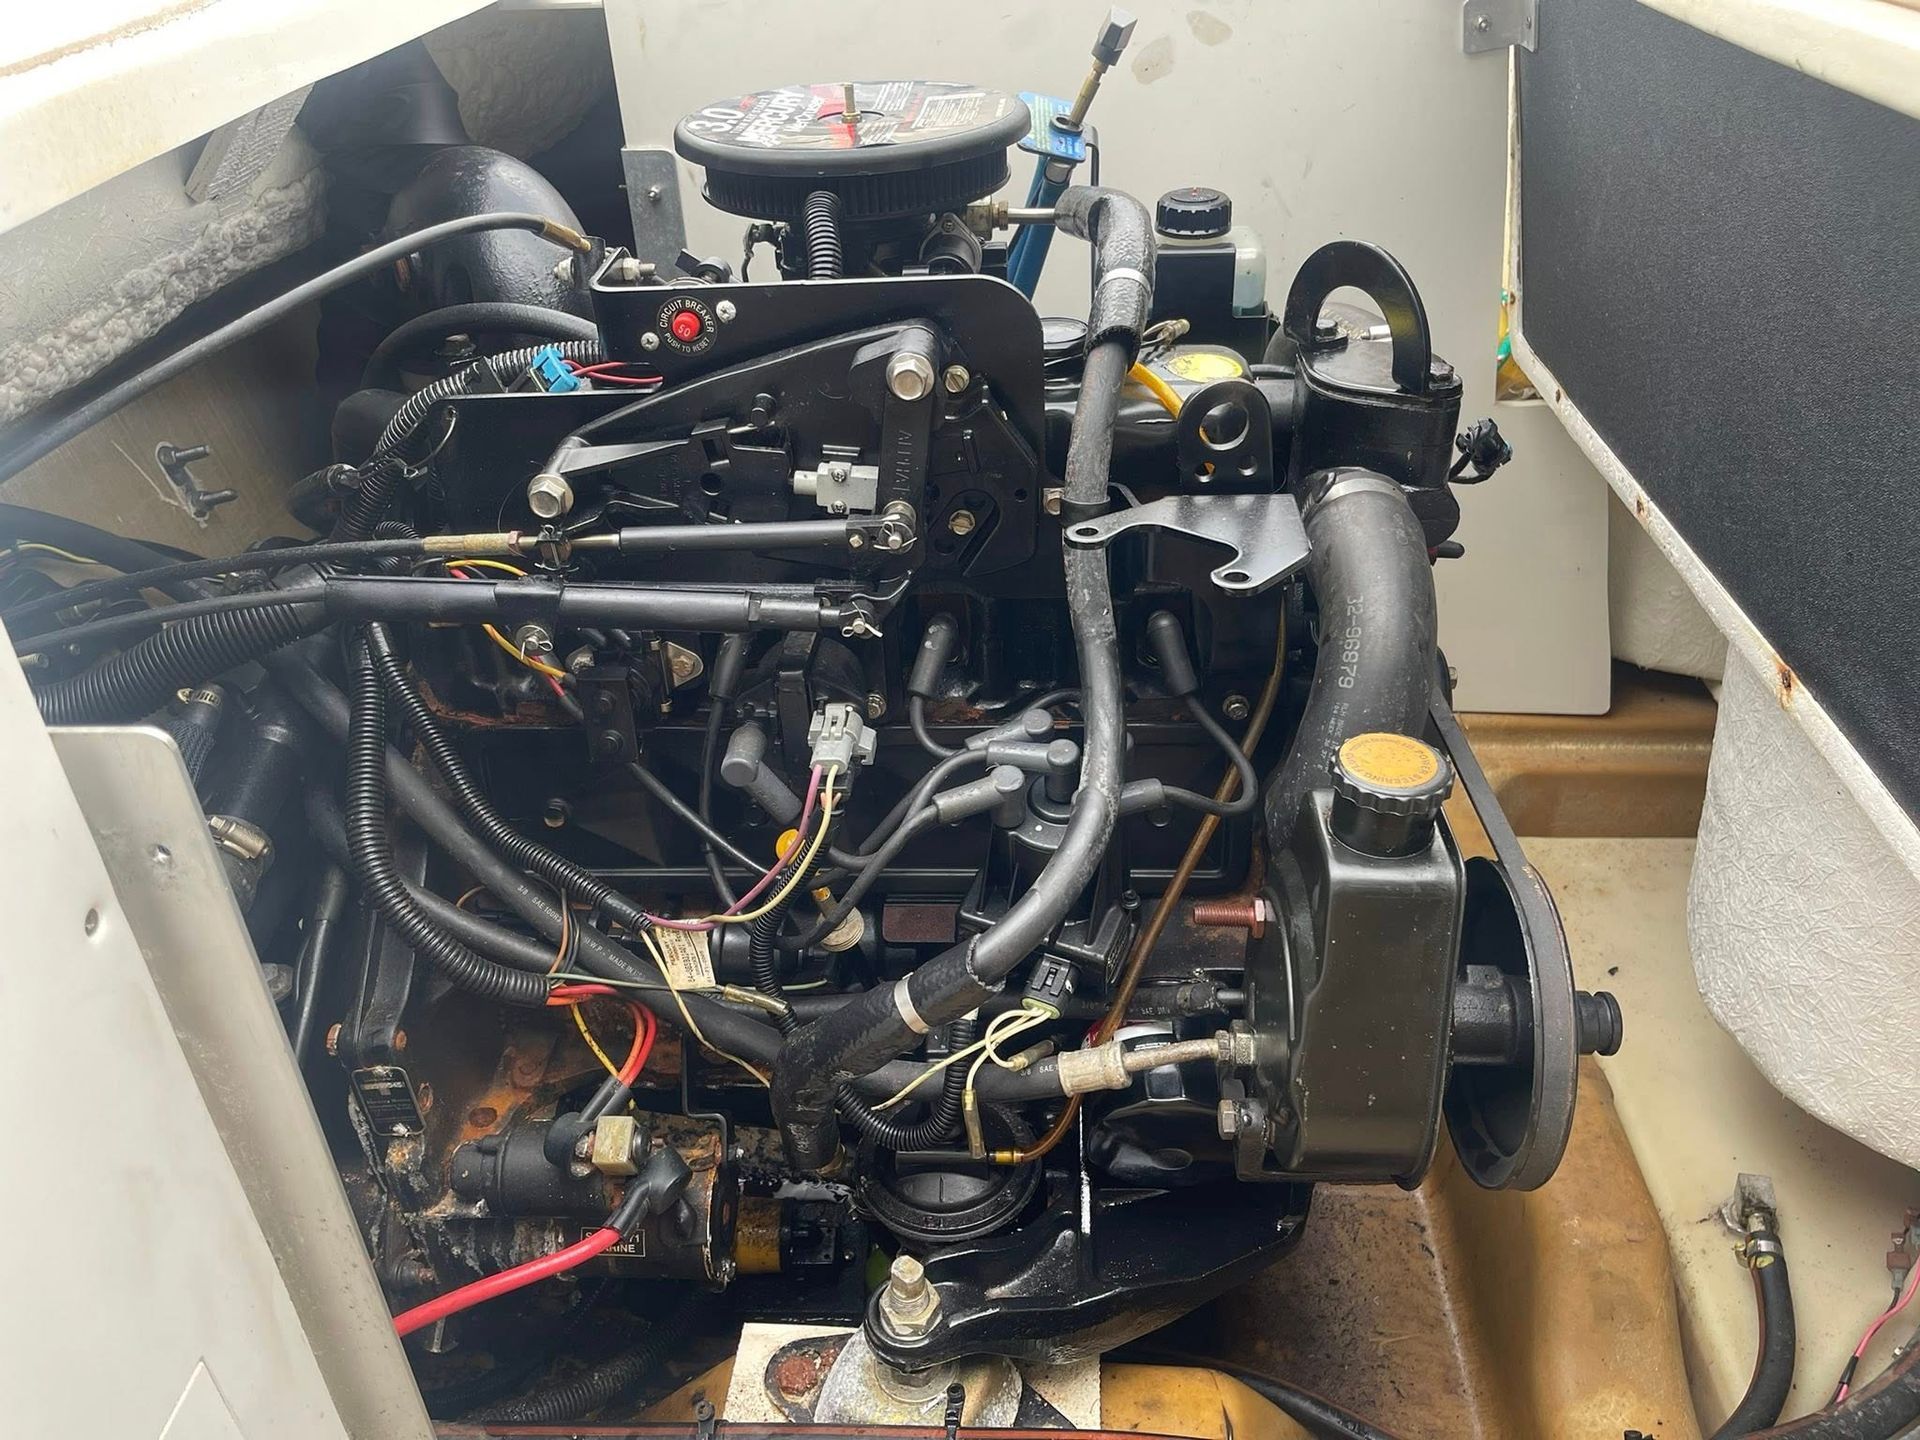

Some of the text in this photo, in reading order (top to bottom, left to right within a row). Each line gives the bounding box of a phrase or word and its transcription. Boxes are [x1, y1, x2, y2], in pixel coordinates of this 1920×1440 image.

[687, 107, 745, 133] 3.0
[735, 89, 805, 142] MERCURY
[660, 299, 714, 333] CIRCUIT BREAKER
[678, 324, 691, 337] 50
[664, 332, 710, 353] PUSH TO RESET
[1338, 594, 1364, 689] 32-96879
[531, 896, 545, 910] SAE
[608, 953, 626, 969] MADE
[1039, 1064, 1054, 1075] SAE
